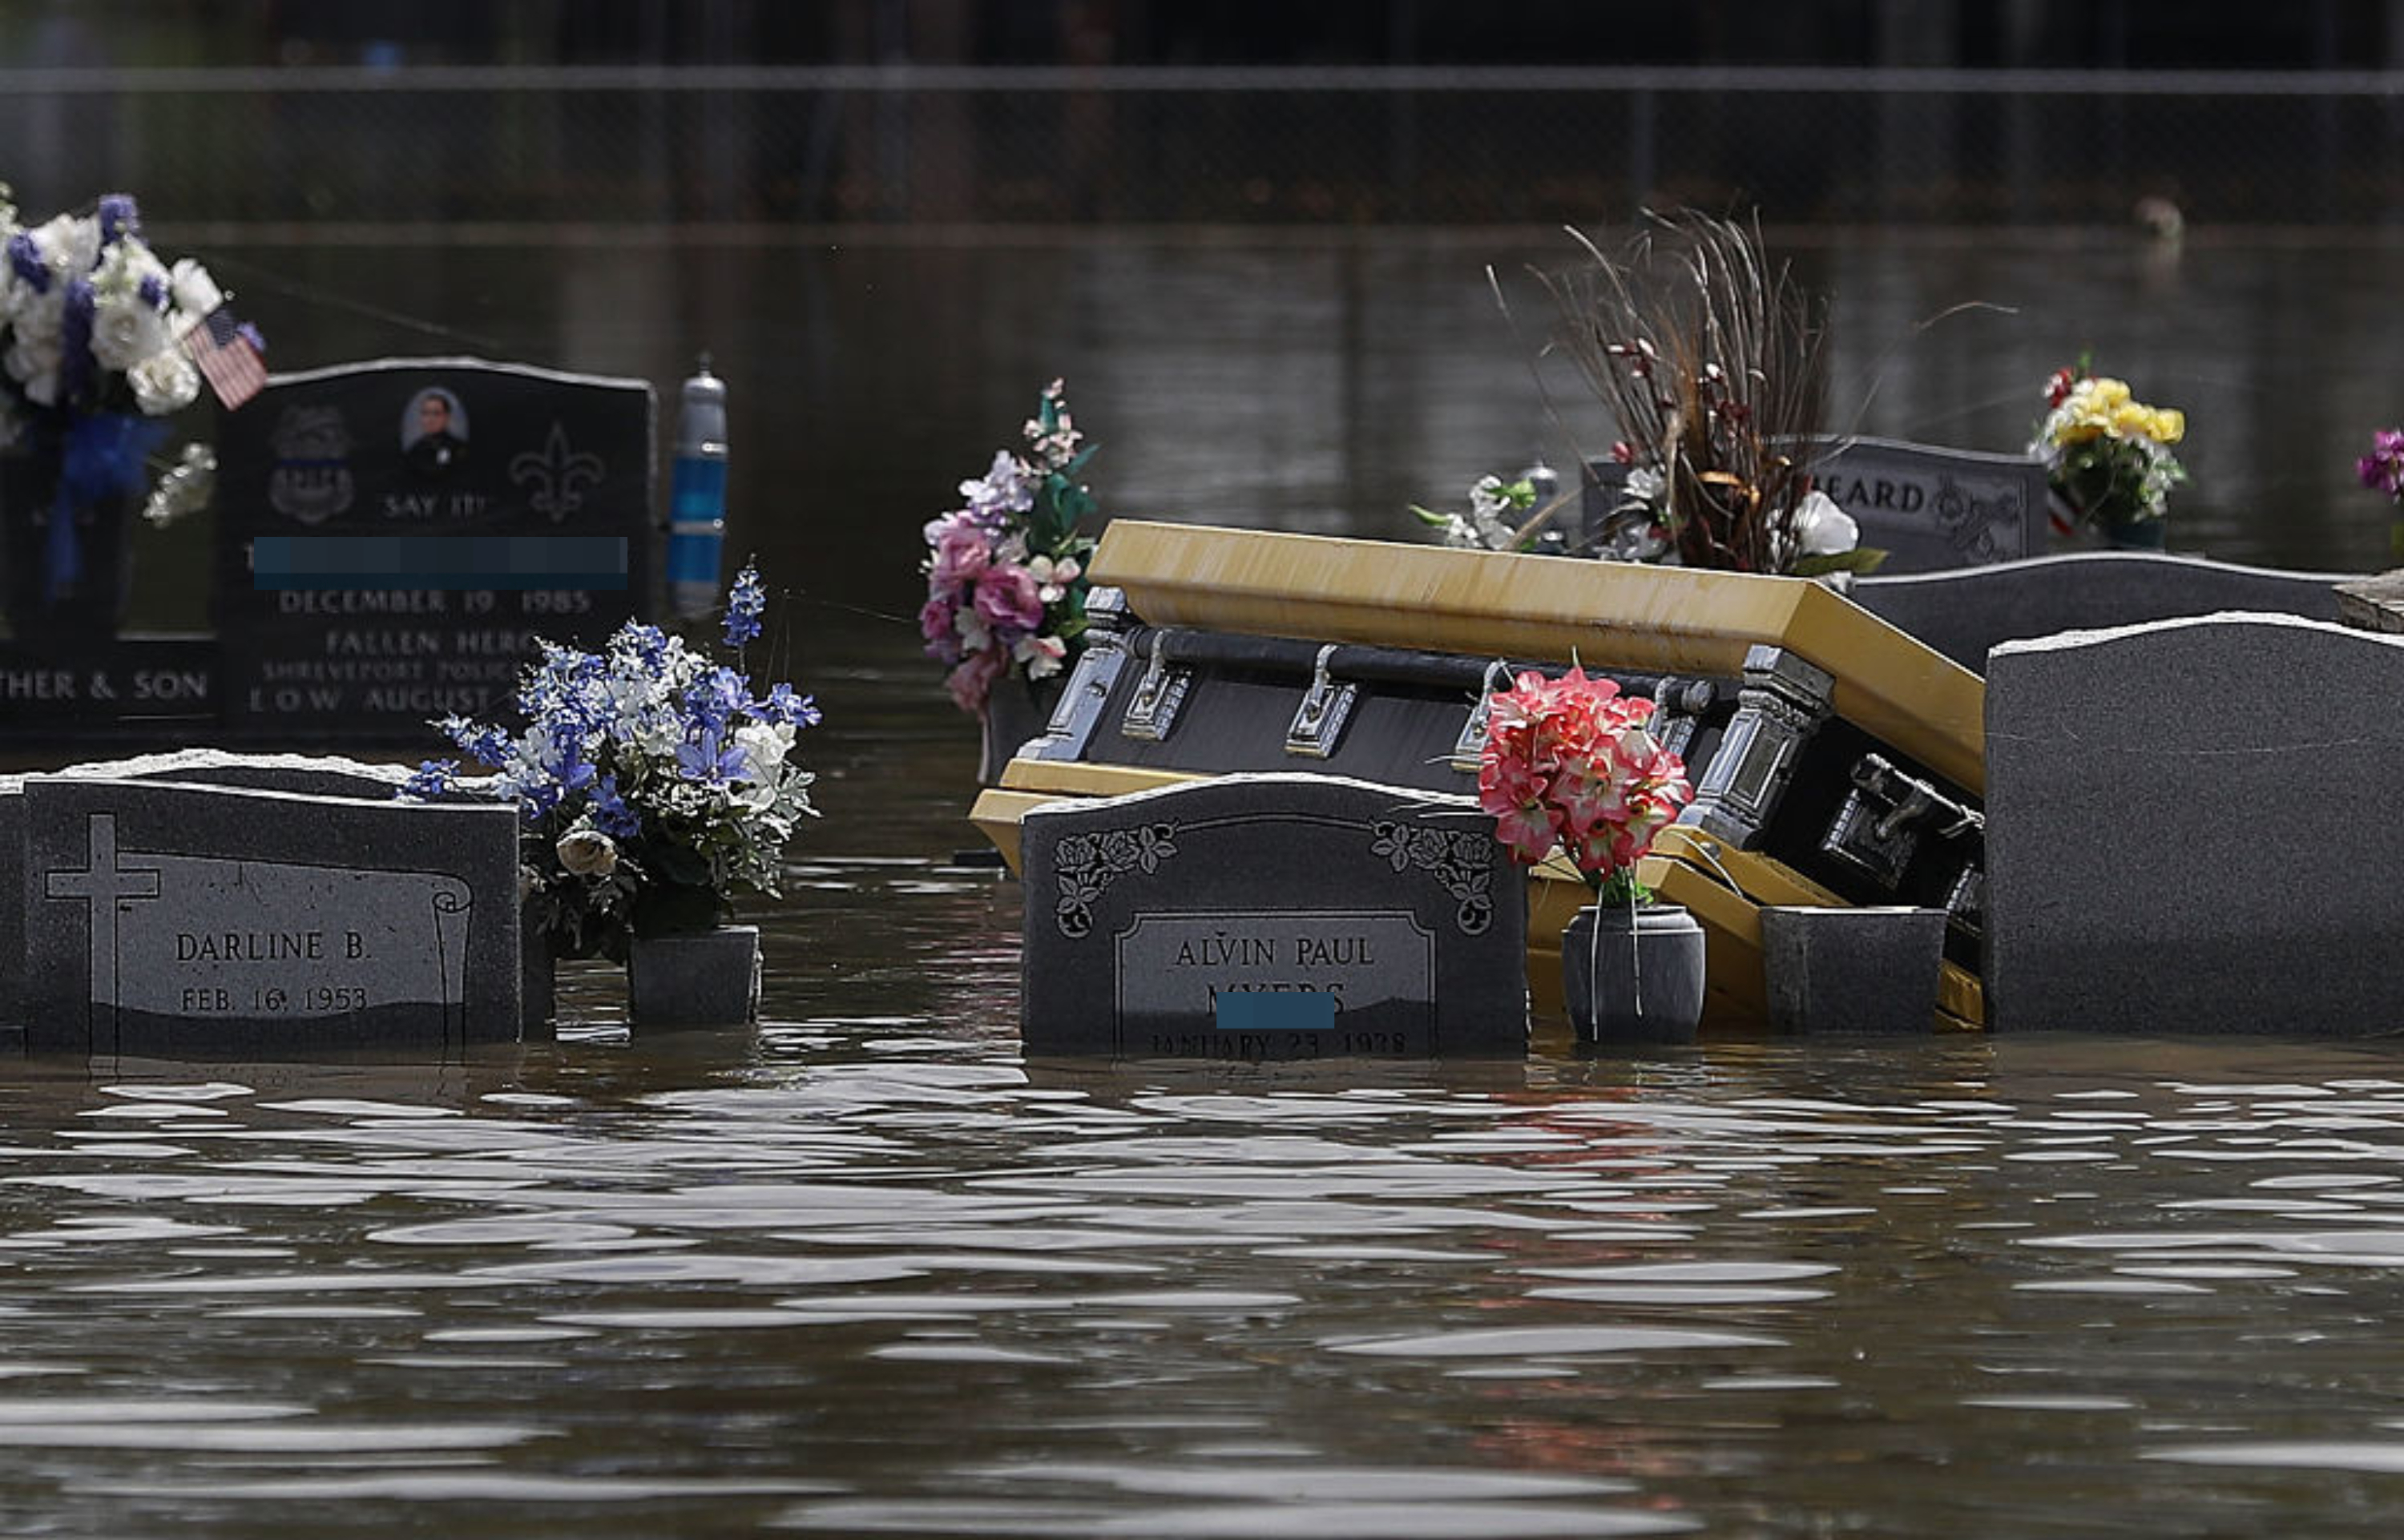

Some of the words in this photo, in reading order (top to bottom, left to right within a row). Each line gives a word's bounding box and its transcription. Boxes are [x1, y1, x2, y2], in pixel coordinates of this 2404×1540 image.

[1811, 474, 1924, 513] EARD
[280, 589, 446, 614] DECEMBER
[465, 589, 494, 615] 19
[326, 631, 440, 655] FALLEN
[0, 671, 76, 698] HER
[90, 671, 115, 699] &
[132, 671, 208, 699] SON
[364, 687, 490, 712] AUGUST
[176, 932, 323, 961] DARLINE
[345, 931, 373, 960] B.
[1176, 938, 1276, 966] ALVIN
[1297, 938, 1374, 966] PAUL
[182, 988, 236, 1011] FEB.
[305, 987, 367, 1012] 1953
